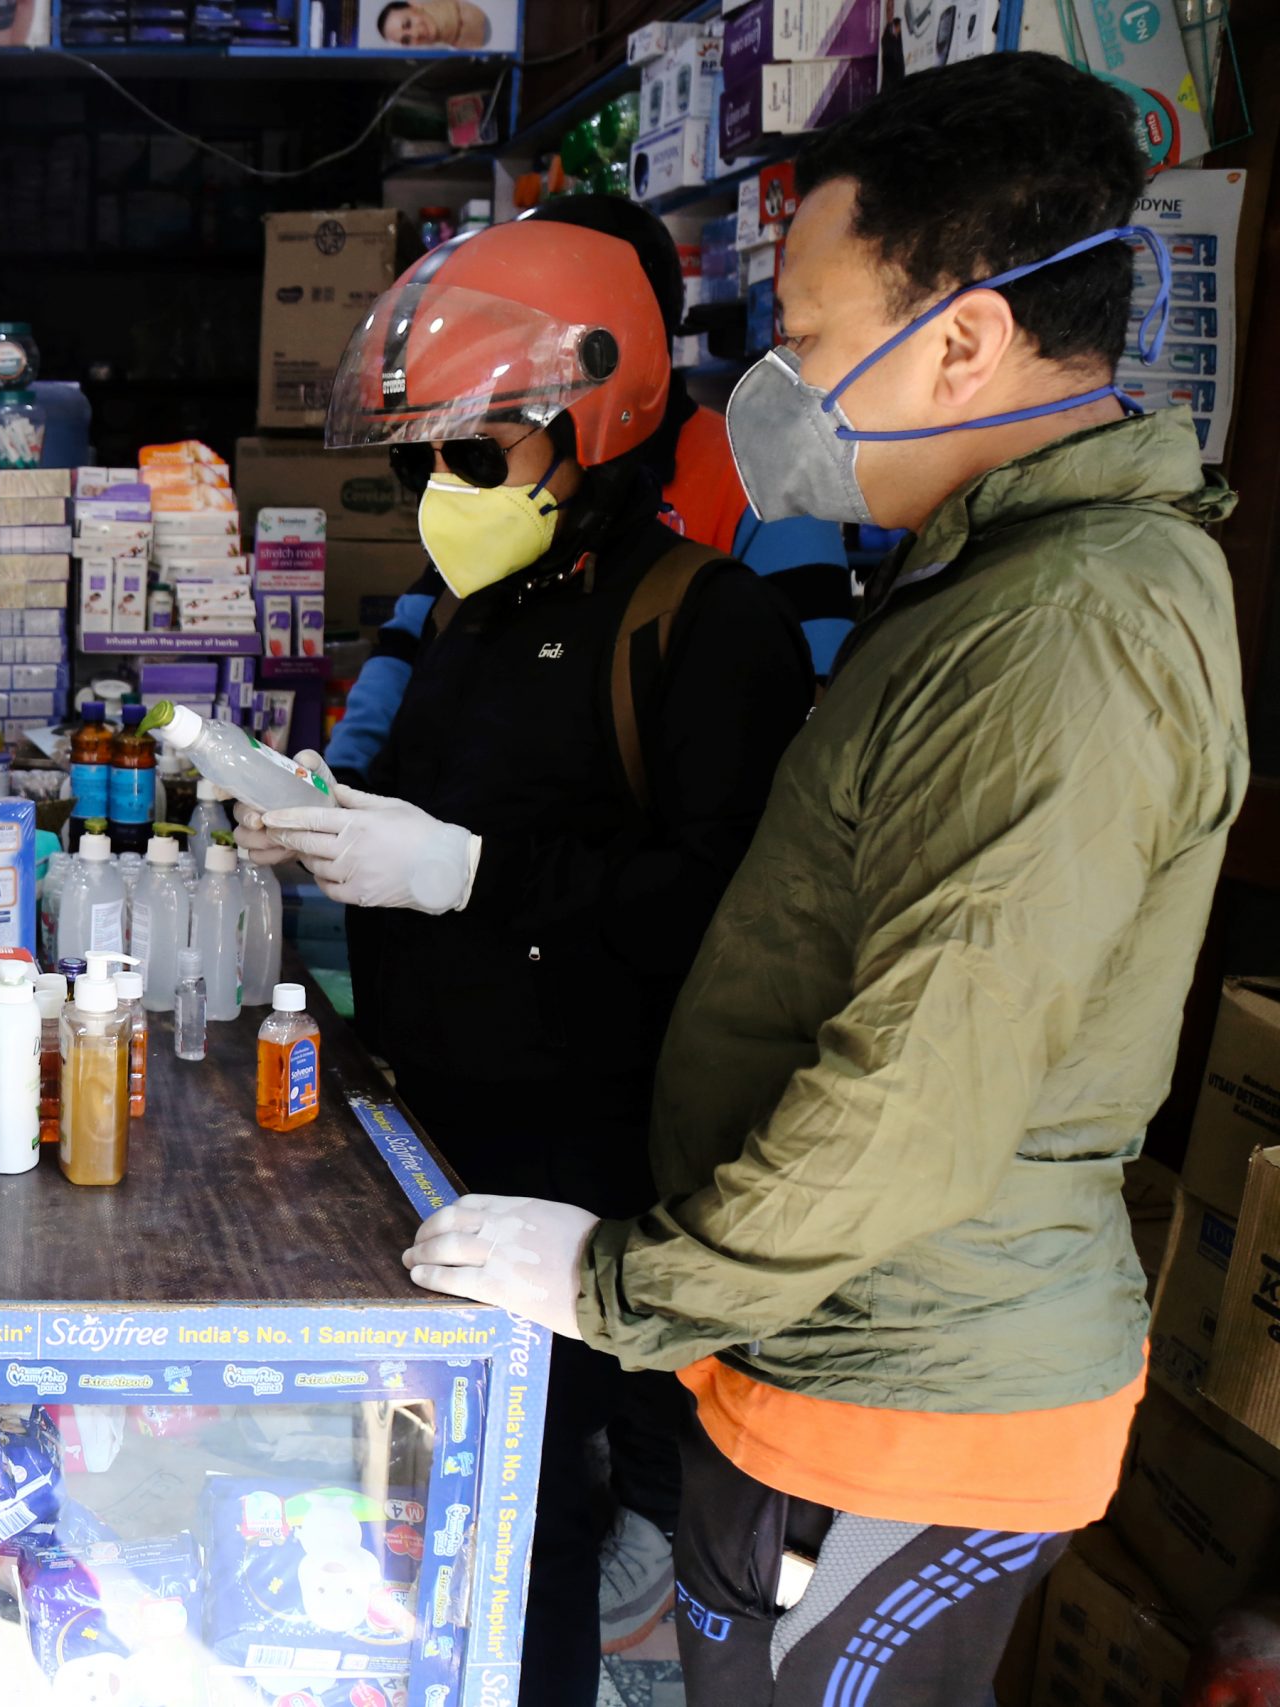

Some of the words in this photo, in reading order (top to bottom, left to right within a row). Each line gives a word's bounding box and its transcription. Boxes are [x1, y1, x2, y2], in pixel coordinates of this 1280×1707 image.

[106, 635, 138, 646] Infused
[140, 635, 158, 646] with
[160, 635, 174, 646] the
[176, 636, 203, 649] power
[205, 635, 214, 646] of
[215, 635, 240, 646] herbs
[45, 1316, 168, 1352] Stayfree
[178, 1326, 250, 1344] India's
[256, 1327, 292, 1344] No.
[300, 1327, 310, 1344] 1
[319, 1326, 408, 1348] Sanitary
[79, 1375, 111, 1388] Extra
[111, 1374, 153, 1387] Absorb
[296, 1374, 327, 1387] Extra
[327, 1373, 369, 1386] Absorb
[502, 1455, 522, 1487] No.
[490, 1508, 518, 1585] Sanitary
